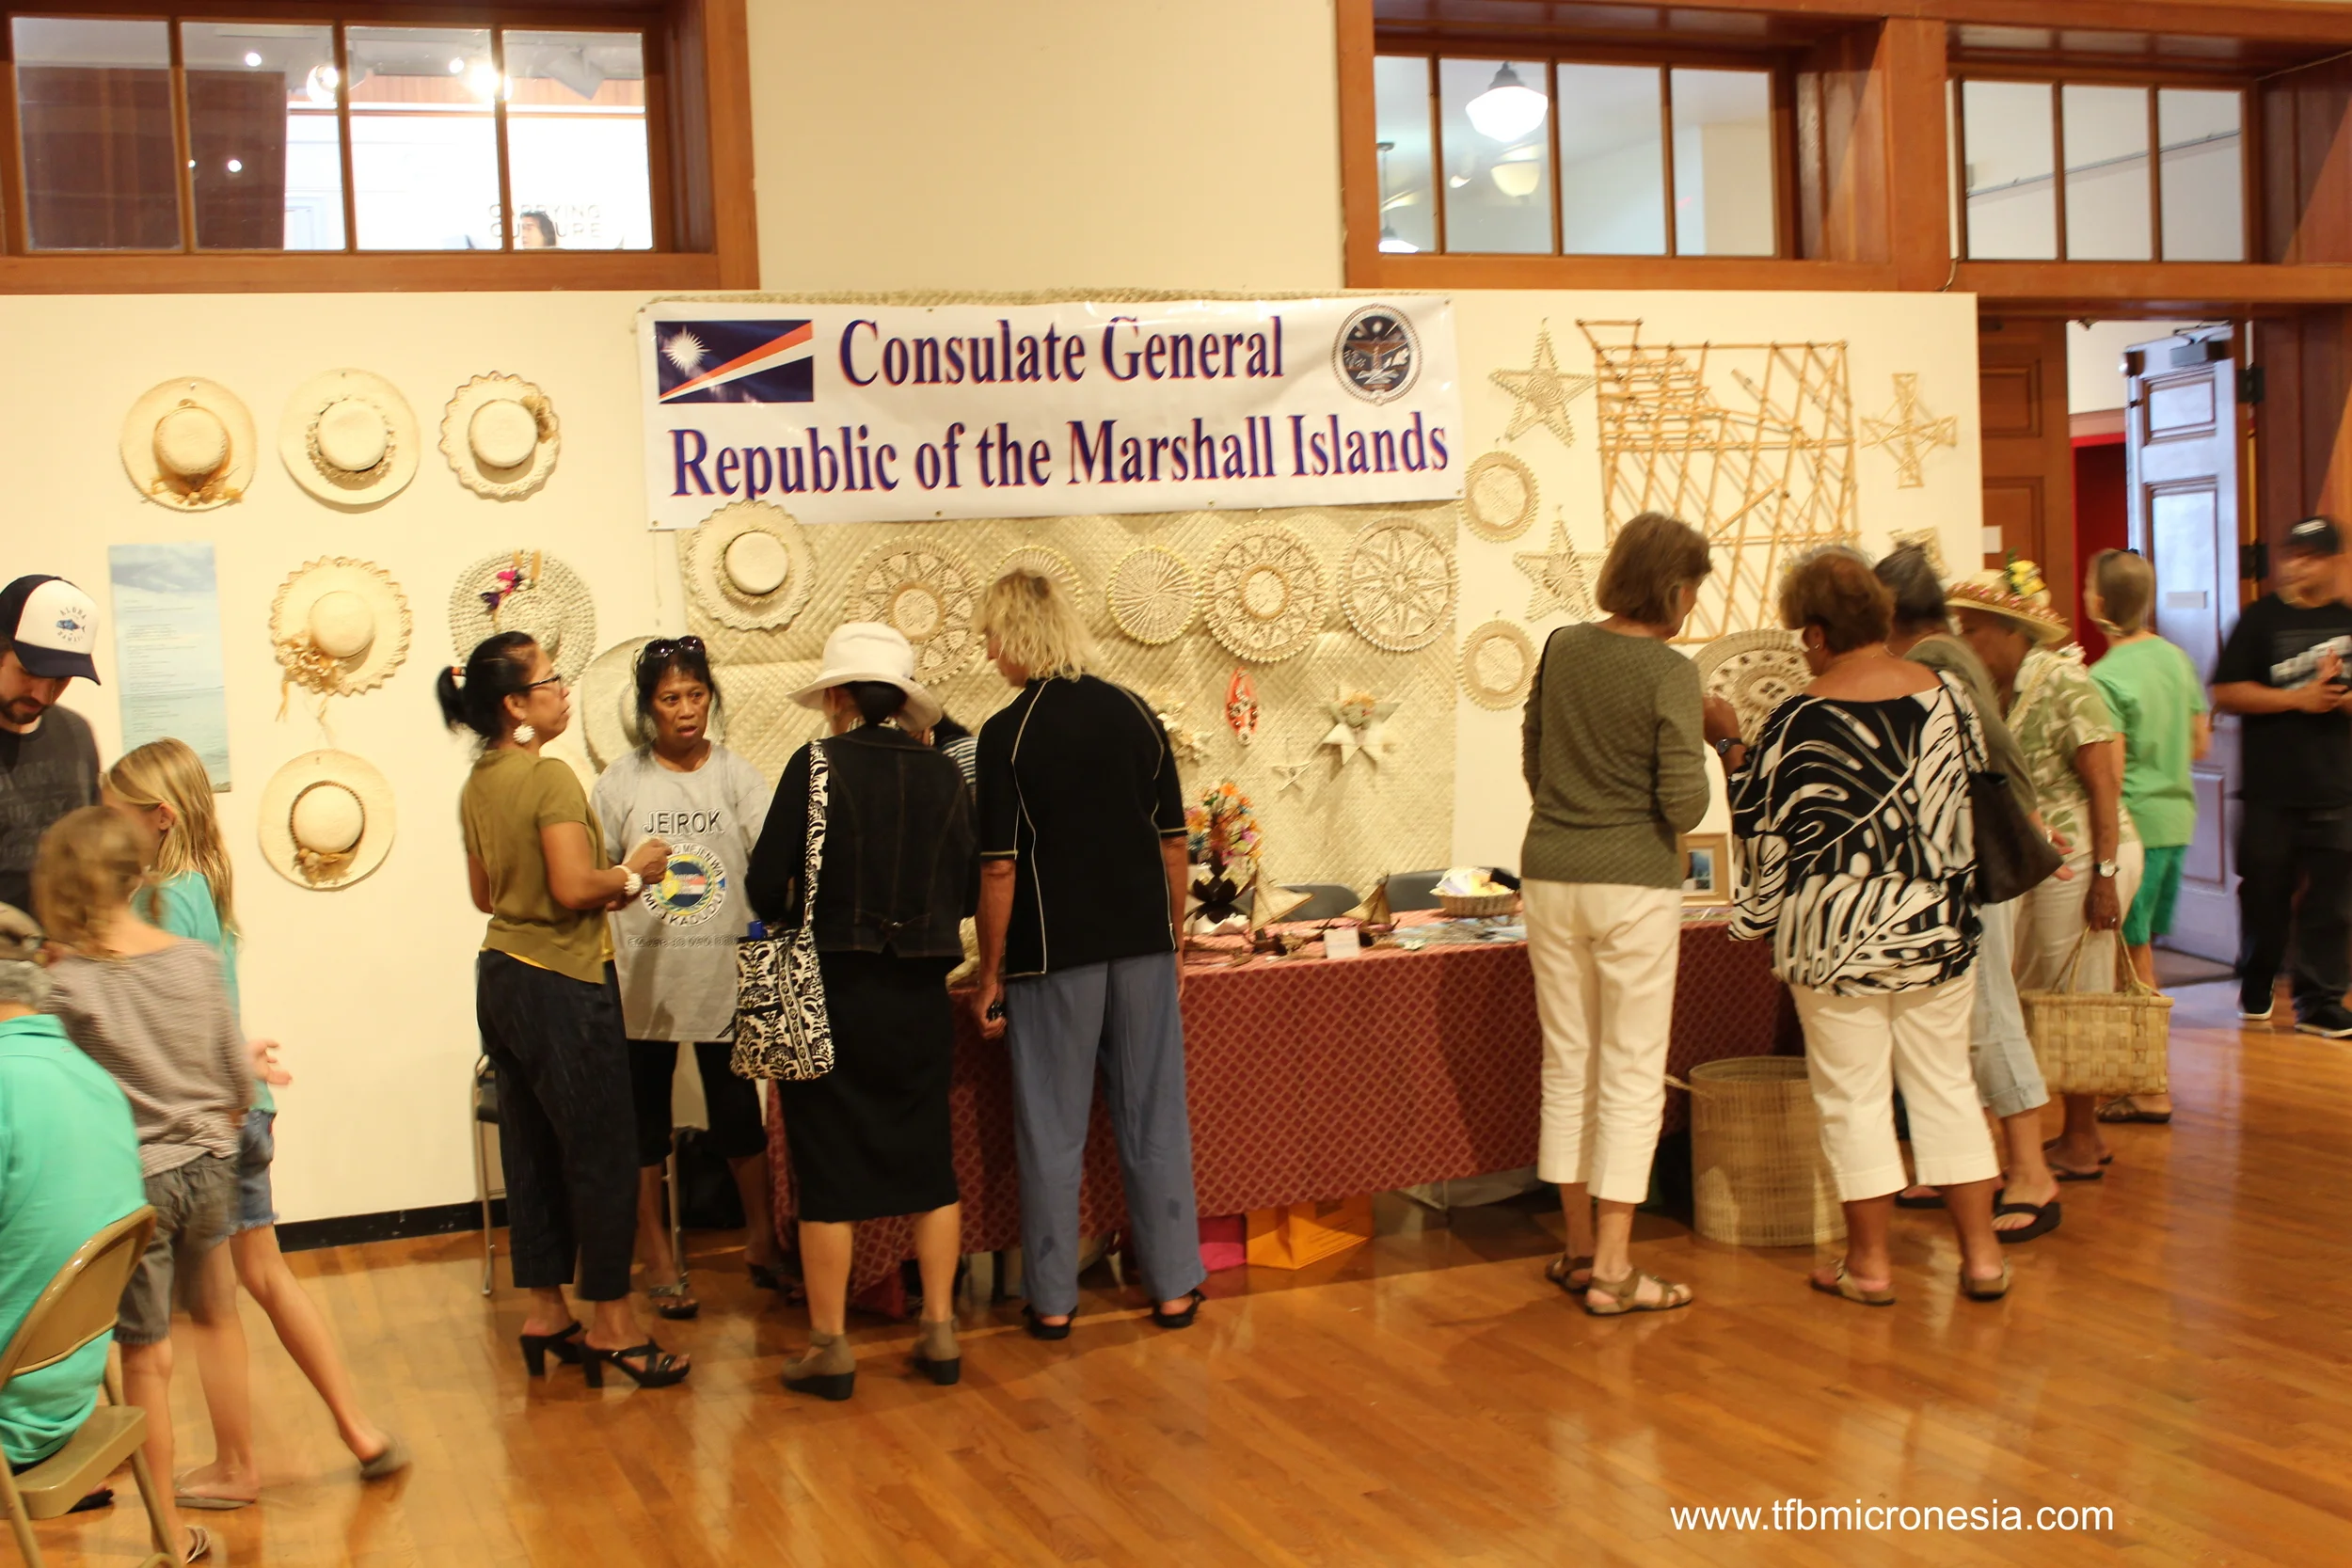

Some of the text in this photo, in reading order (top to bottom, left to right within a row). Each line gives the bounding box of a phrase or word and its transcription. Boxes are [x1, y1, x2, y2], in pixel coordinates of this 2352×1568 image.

[489, 222, 602, 238] CUURE
[837, 319, 1088, 388] Consulate
[1100, 314, 1285, 382] General
[668, 411, 1449, 503] Republic of the Marshall Islands
[644, 810, 724, 835] JEIROK
